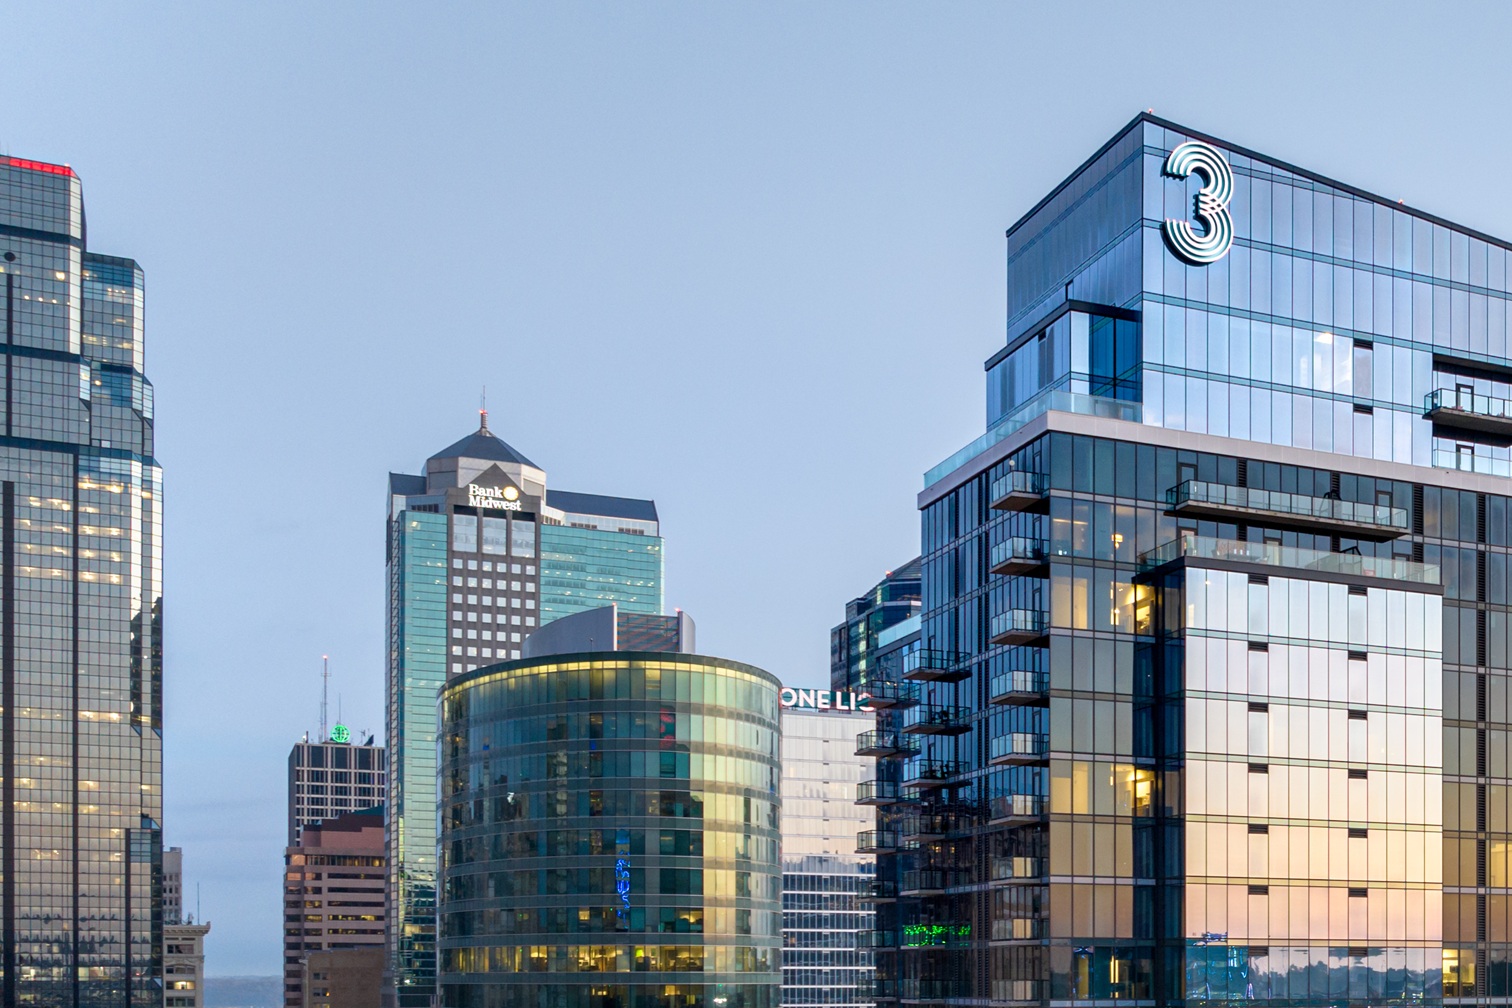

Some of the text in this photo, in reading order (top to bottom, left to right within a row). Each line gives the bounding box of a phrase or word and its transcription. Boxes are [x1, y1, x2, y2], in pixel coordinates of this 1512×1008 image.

[1165, 141, 1234, 264] 3
[468, 484, 503, 498] Bank
[468, 495, 522, 511] Midwest
[780, 687, 830, 709] ONE
